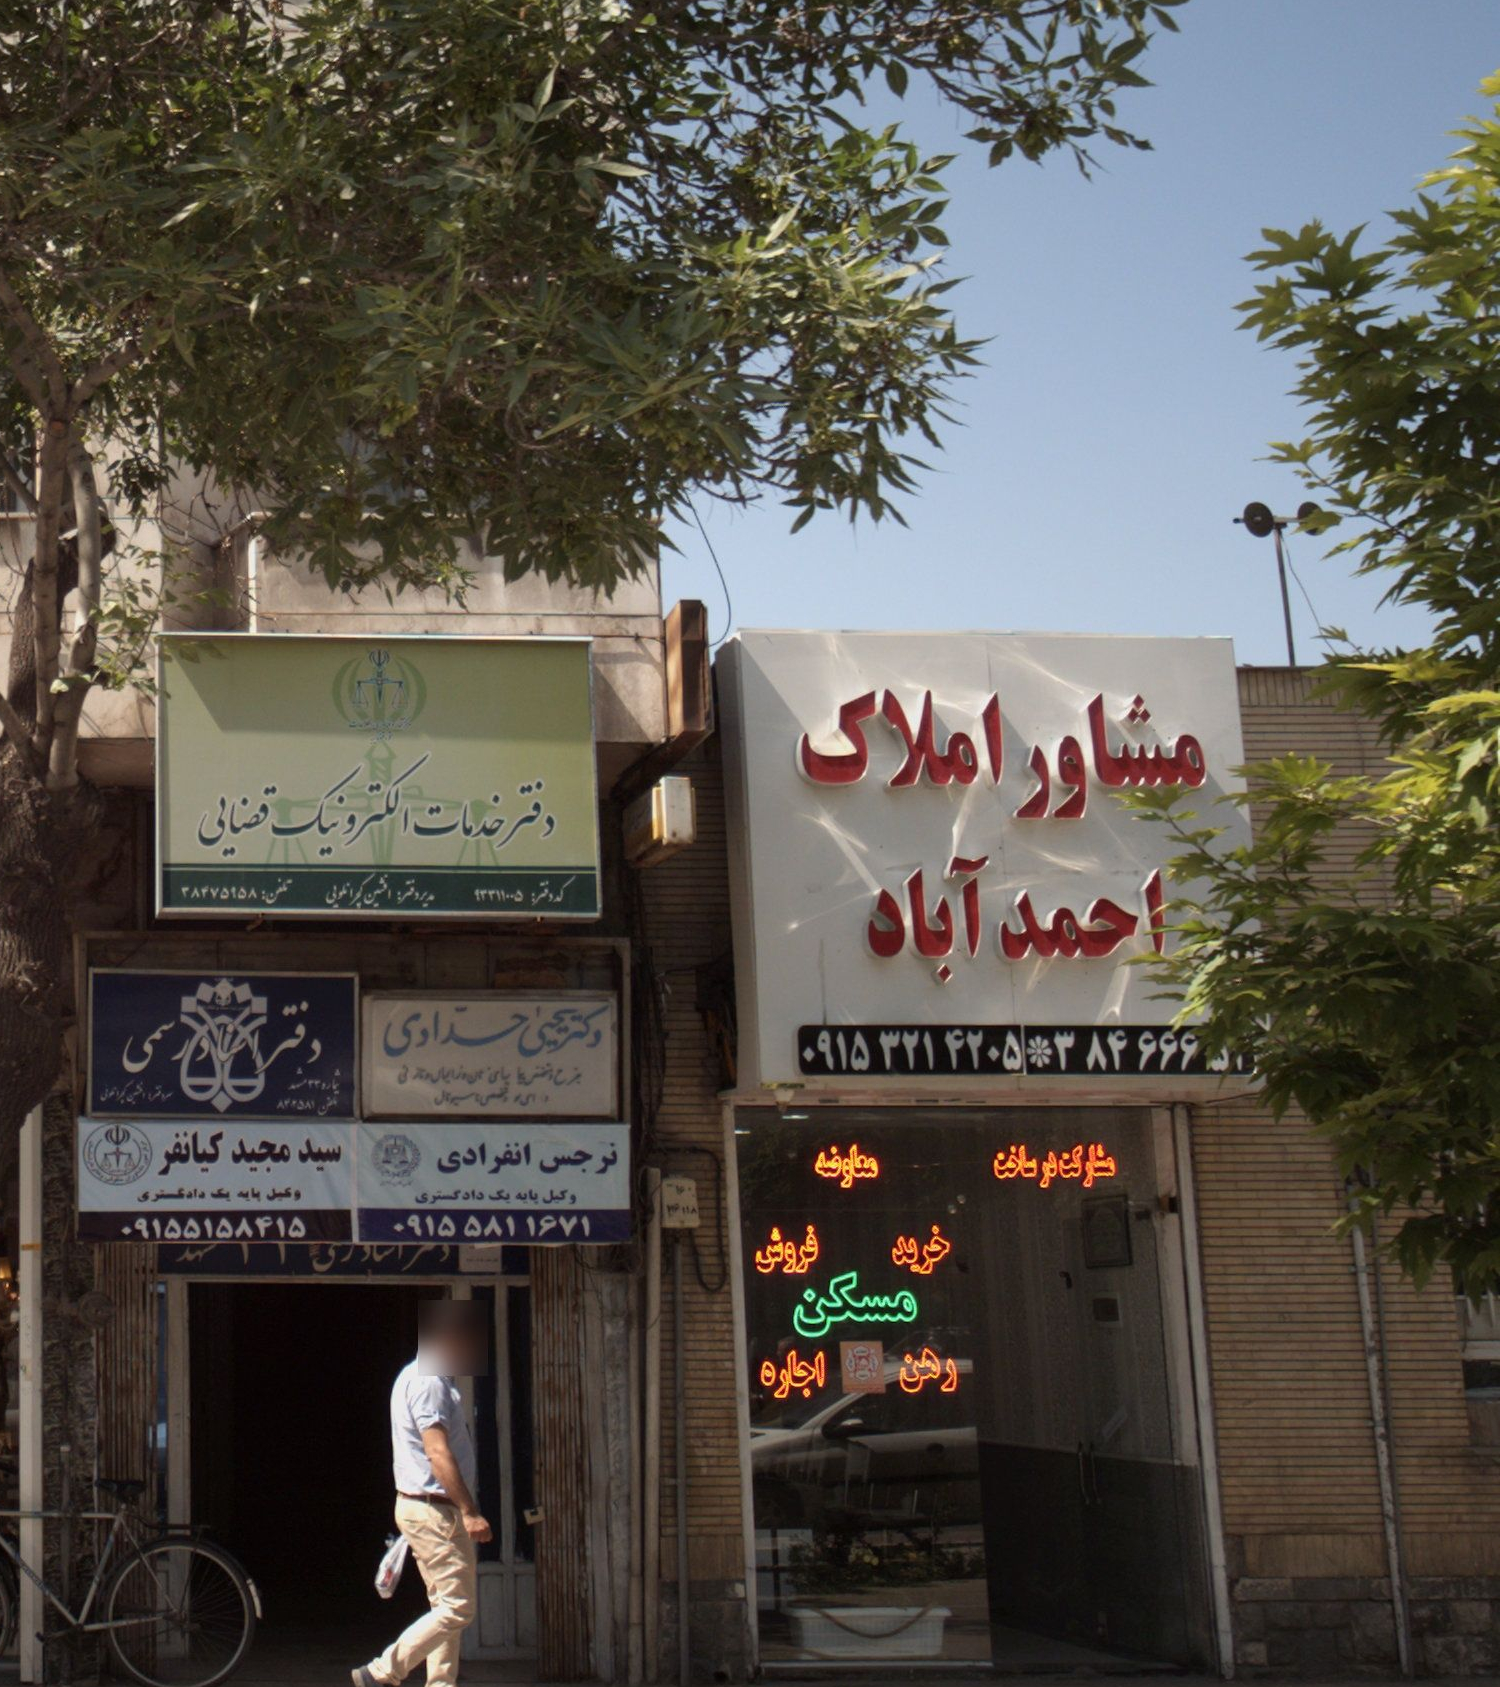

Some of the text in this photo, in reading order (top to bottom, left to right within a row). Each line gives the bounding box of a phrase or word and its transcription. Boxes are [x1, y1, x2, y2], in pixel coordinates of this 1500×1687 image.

[799, 688, 1207, 820] مشاور املاک
[270, 752, 430, 857] الکترونیک
[413, 793, 505, 837] خدمات
[496, 780, 556, 849] دفتر
[867, 855, 1166, 985] احمد آباد
[121, 1020, 190, 1074] رسمی
[254, 1000, 322, 1075] دفتر
[546, 1004, 610, 1055] دکتر
[802, 1028, 1023, 1072] ۰۹۱۵ ۳۲۱ ۴۲۰۵
[157, 1130, 224, 1176] کیانفر
[231, 1137, 291, 1173] مجید
[297, 1136, 342, 1173] سید
[436, 1141, 531, 1174] انفرادی
[539, 1142, 618, 1175] نرجس
[814, 1143, 880, 1188] معاوضه
[136, 1186, 302, 1204] وکیل پایه یک دادگستری
[414, 1189, 577, 1205] وکیل پایه یک دادگستری
[120, 1215, 307, 1240] ۰۹۱۵۵۱۵۸۴۱۵
[393, 1213, 591, 1238] ۰۹۱۵ ۵۸۱ ۱۶۷۱
[755, 1224, 951, 1274] خرید فروش
[792, 1270, 919, 1339] مسکن
[760, 1347, 959, 1399] رهن اجاره
